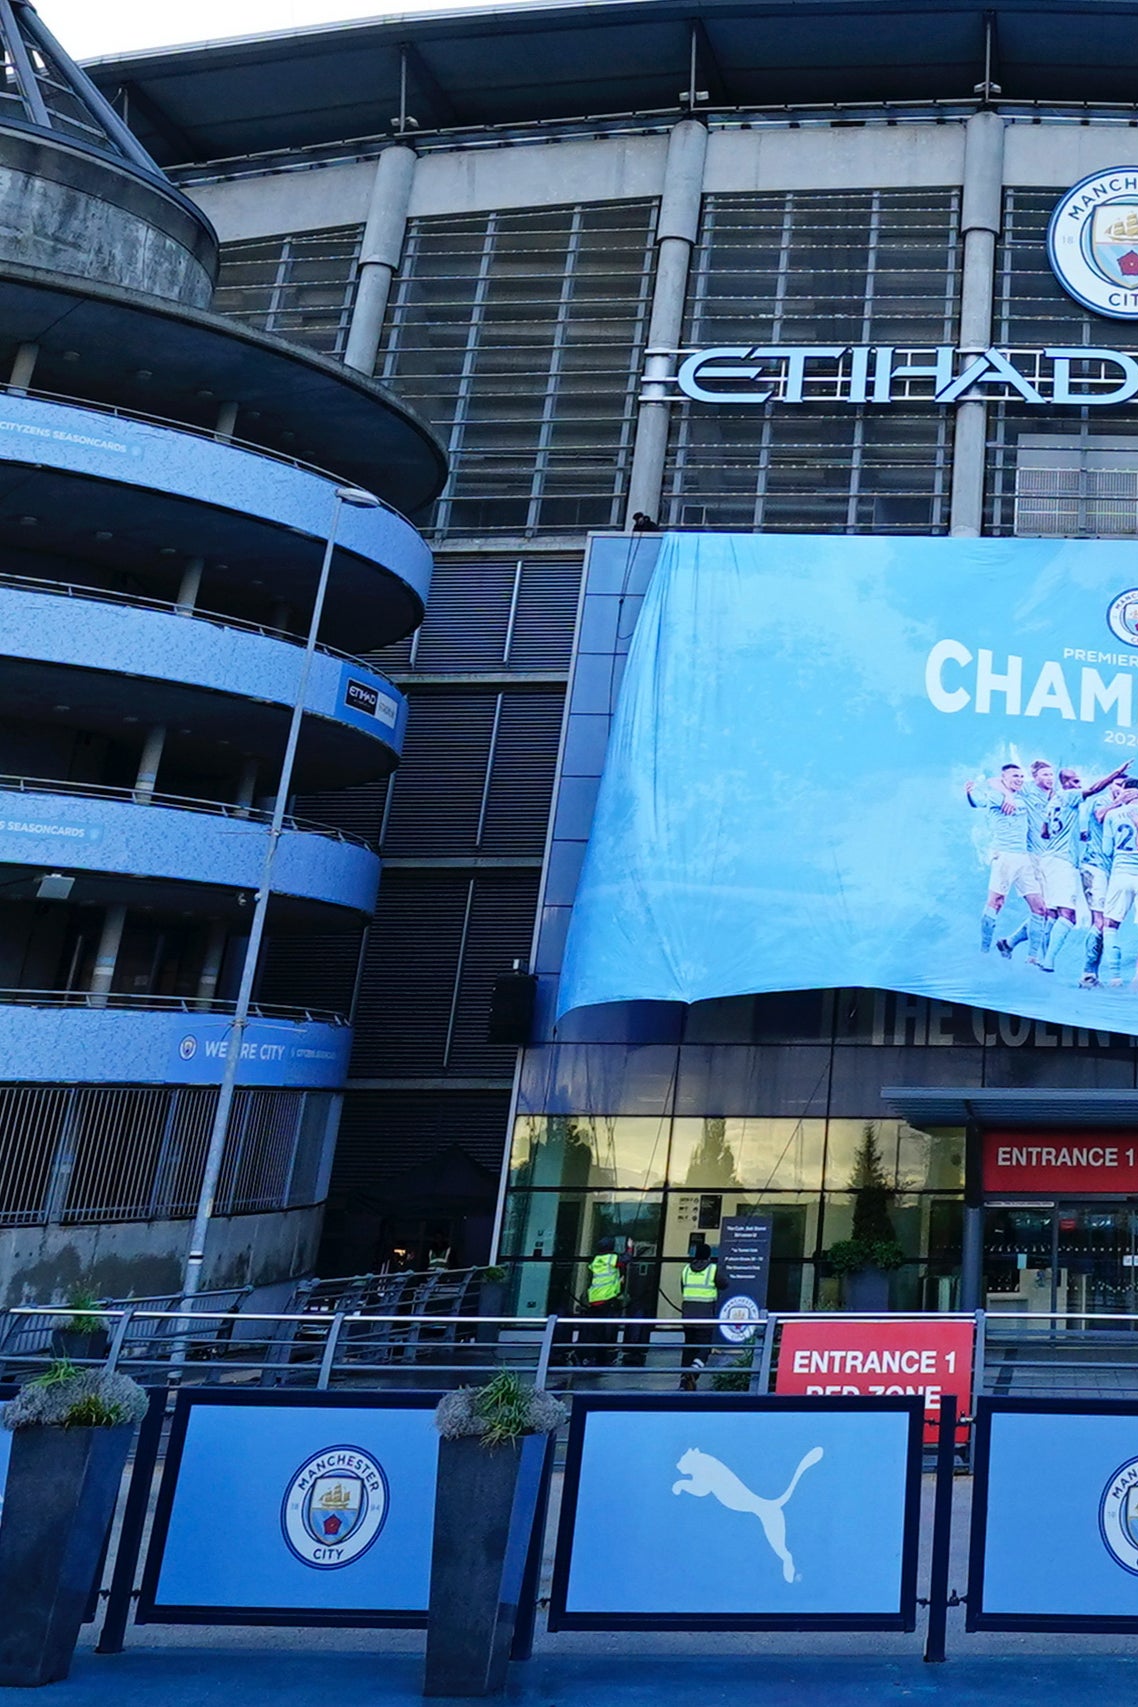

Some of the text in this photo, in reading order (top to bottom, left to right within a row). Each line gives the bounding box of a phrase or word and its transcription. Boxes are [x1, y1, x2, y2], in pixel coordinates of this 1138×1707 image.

[0, 421, 127, 452] CITYZENS SEASONCARDS
[8, 821, 85, 838] SEASONCARDS
[205, 1041, 229, 1058] WE
[234, 1043, 257, 1059] RE
[260, 1044, 286, 1060] CITY
[997, 1147, 1119, 1167] ENTRANCE
[1126, 1148, 1135, 1167] 1
[793, 1350, 956, 1374] ENTRANCE 1
[298, 1454, 380, 1561] MANCHESTER CITY
